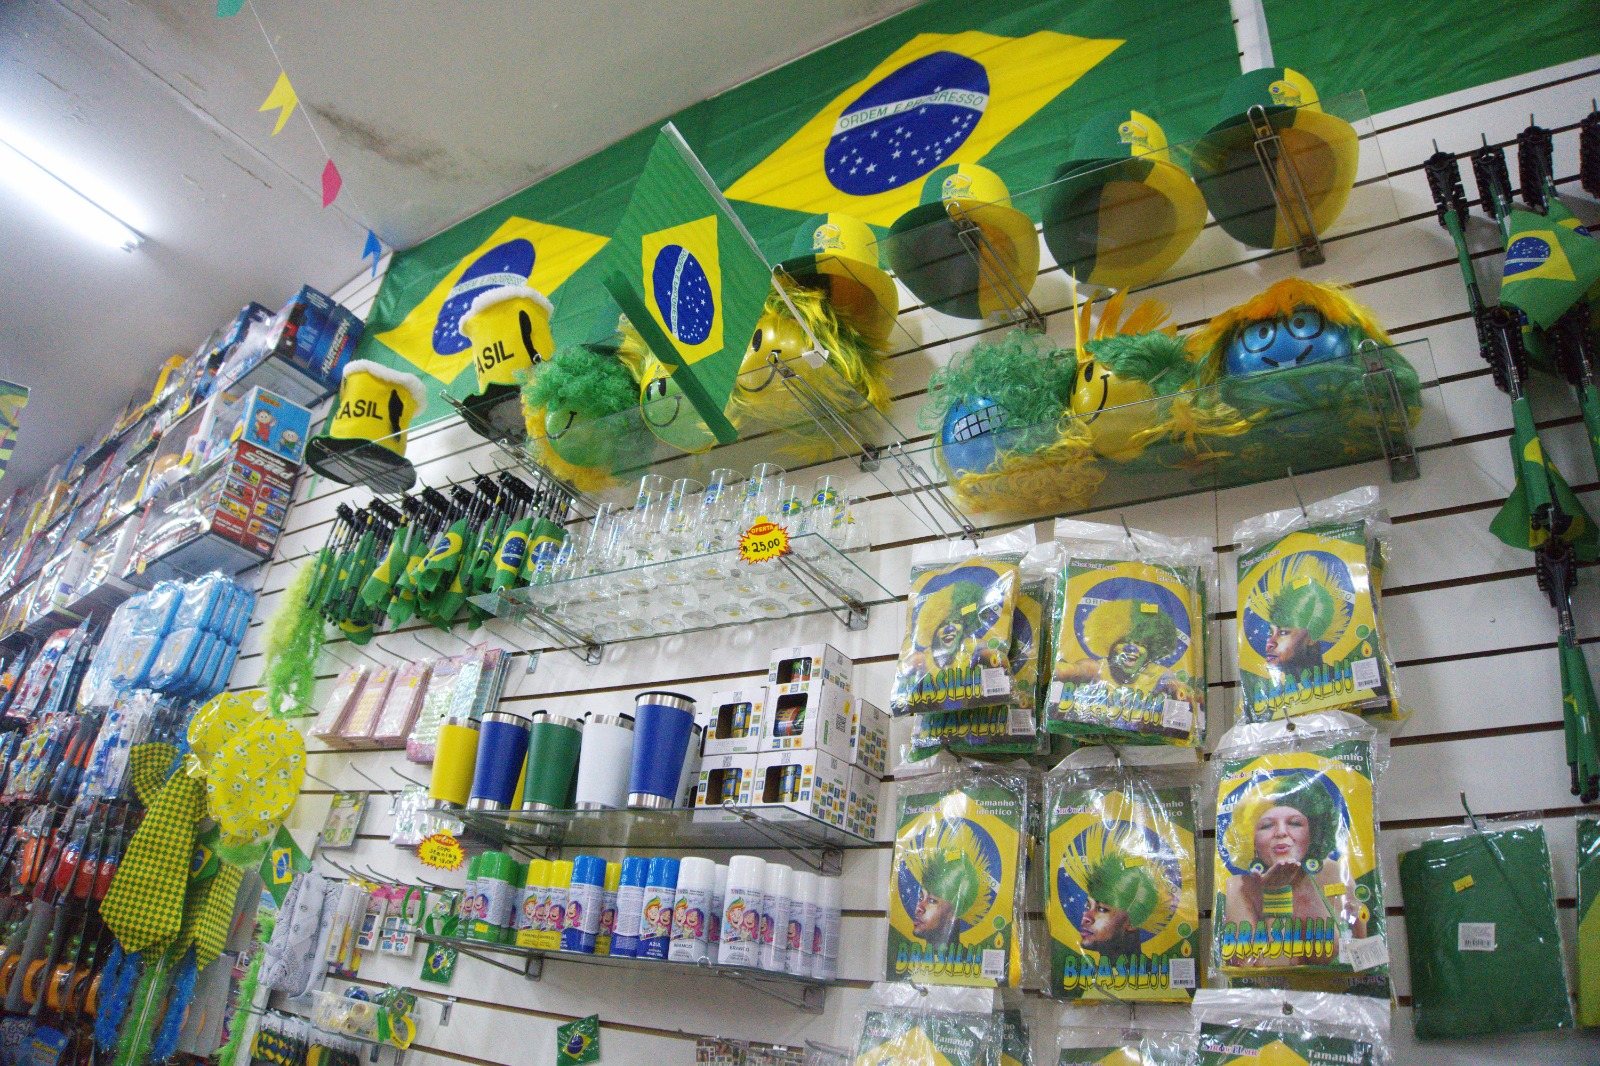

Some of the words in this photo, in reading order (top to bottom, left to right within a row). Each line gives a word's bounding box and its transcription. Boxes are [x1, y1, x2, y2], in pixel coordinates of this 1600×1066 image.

[840, 107, 887, 129] ORDEM
[893, 103, 902, 113] E
[904, 91, 984, 109] PRGRESSO
[475, 340, 515, 375] ASIL
[335, 399, 383, 420] ASIL
[751, 524, 774, 534] OFERTA
[752, 538, 780, 553] 25,00
[897, 665, 984, 709] BRASIL!!
[1254, 657, 1355, 715] BRASIL!!
[975, 799, 1014, 807] Tamanho
[729, 944, 750, 952] BRANCO
[1222, 916, 1335, 961] BRASIL!!!
[896, 941, 983, 978] BRASIL!!
[1063, 953, 1171, 993] BRASIL!!
